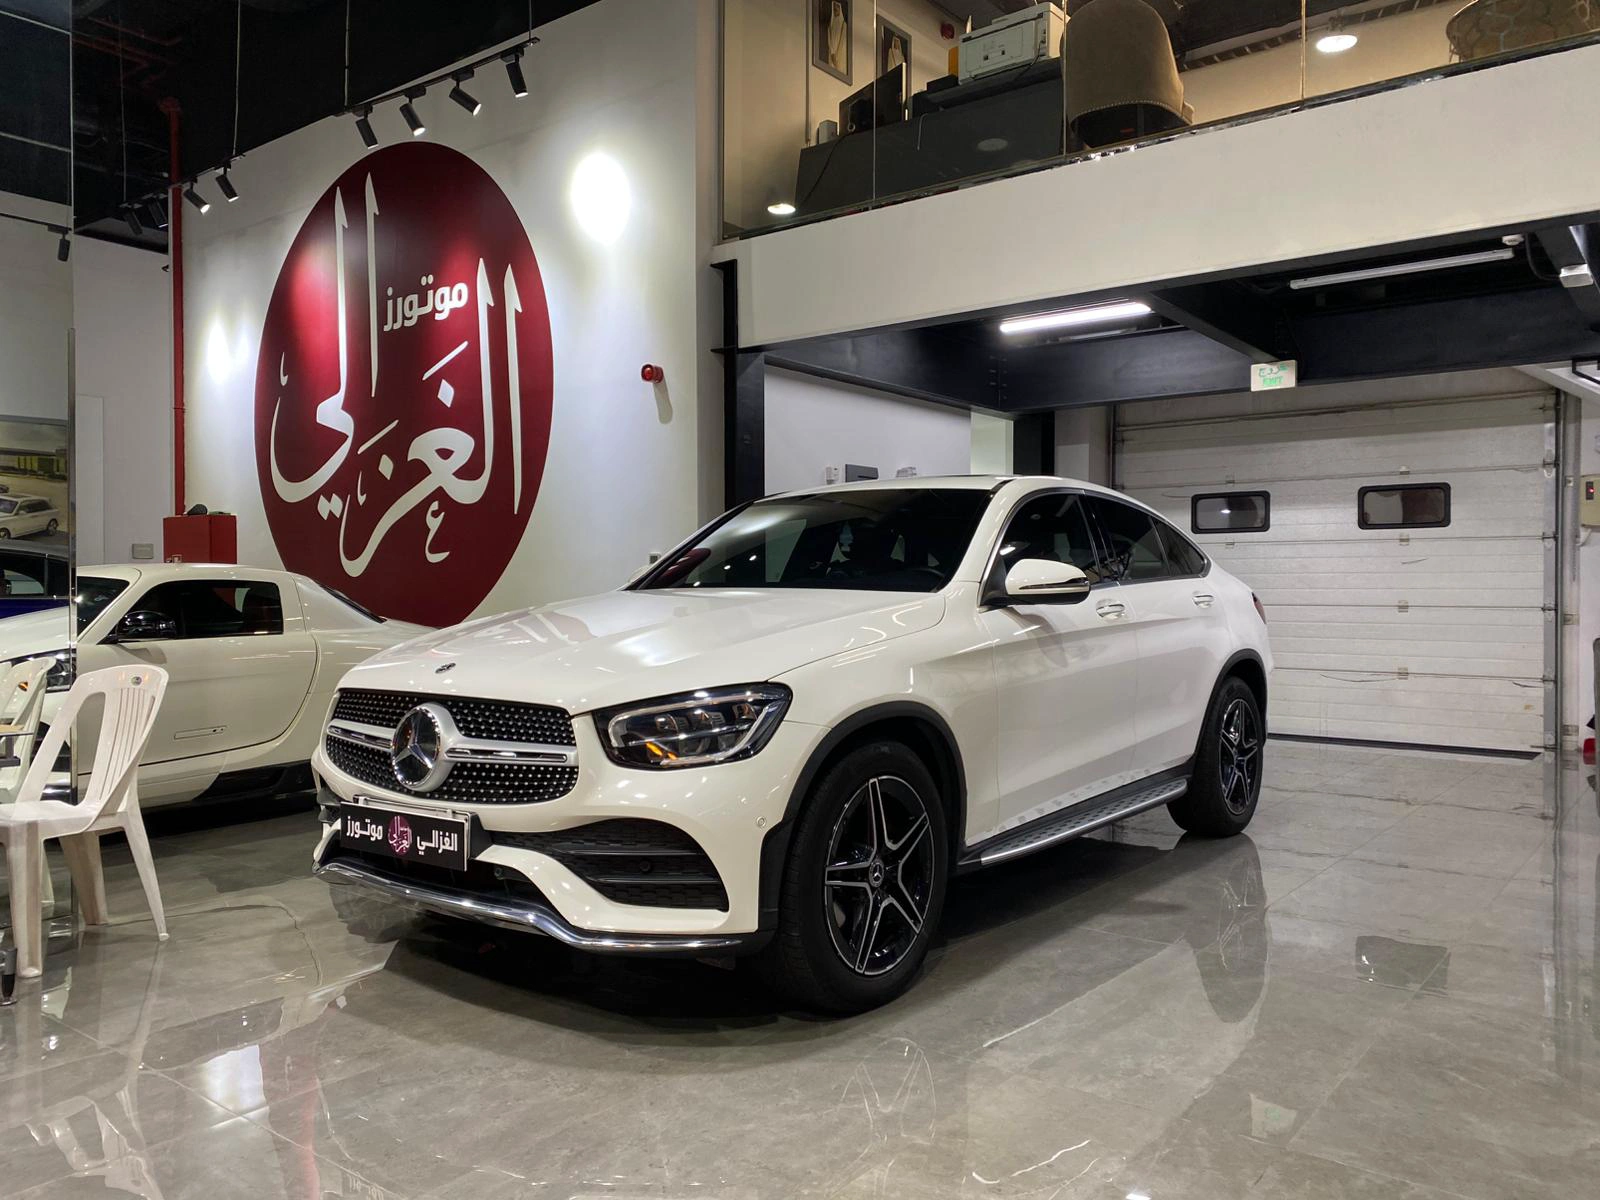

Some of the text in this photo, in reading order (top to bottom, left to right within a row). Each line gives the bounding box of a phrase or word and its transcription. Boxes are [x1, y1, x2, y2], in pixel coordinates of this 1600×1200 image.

[383, 273, 469, 332] موتورز
[346, 815, 458, 855] الغزالي موتورز
